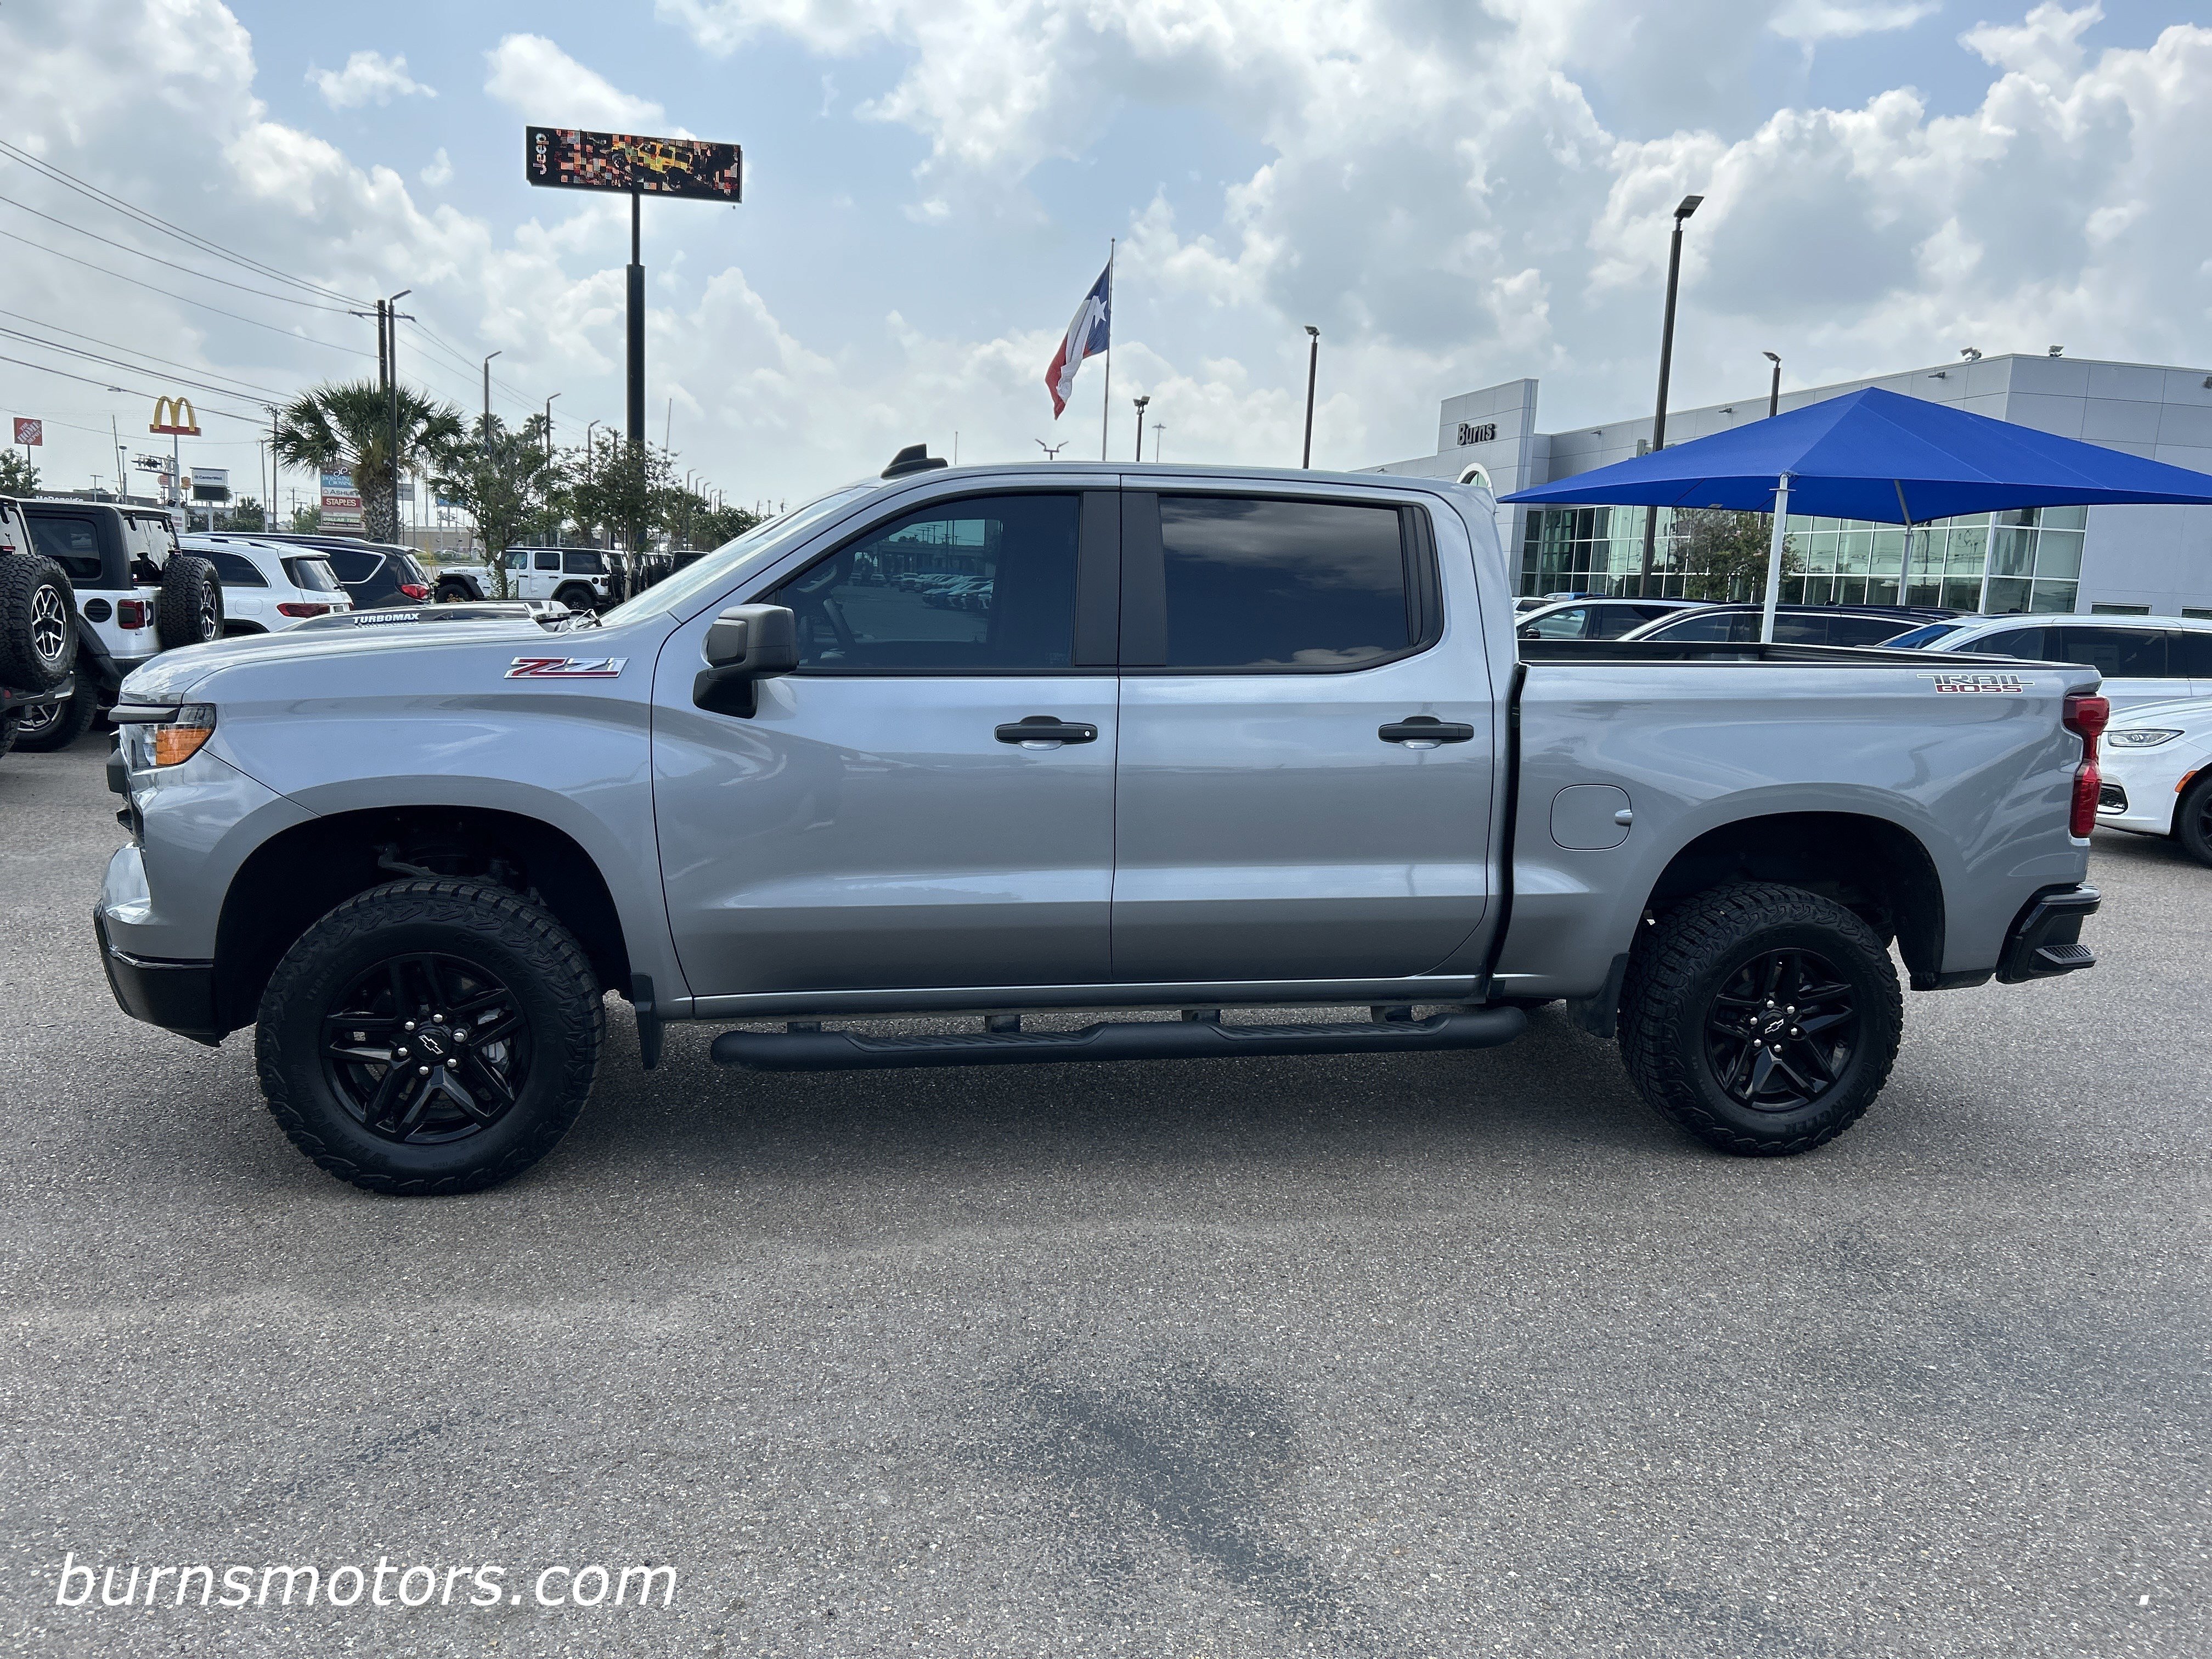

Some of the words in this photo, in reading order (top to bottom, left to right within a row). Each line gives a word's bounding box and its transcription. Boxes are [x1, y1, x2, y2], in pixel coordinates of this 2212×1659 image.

[533, 133, 549, 174] Jeep
[17, 421, 41, 443] HOME
[1457, 423, 1495, 445] Burns
[326, 498, 357, 506] STAPLES
[353, 613, 420, 625] TURBOMAX
[504, 657, 629, 679] Z71
[1917, 673, 2035, 685] TRAIL
[1936, 684, 2023, 693] BOSS
